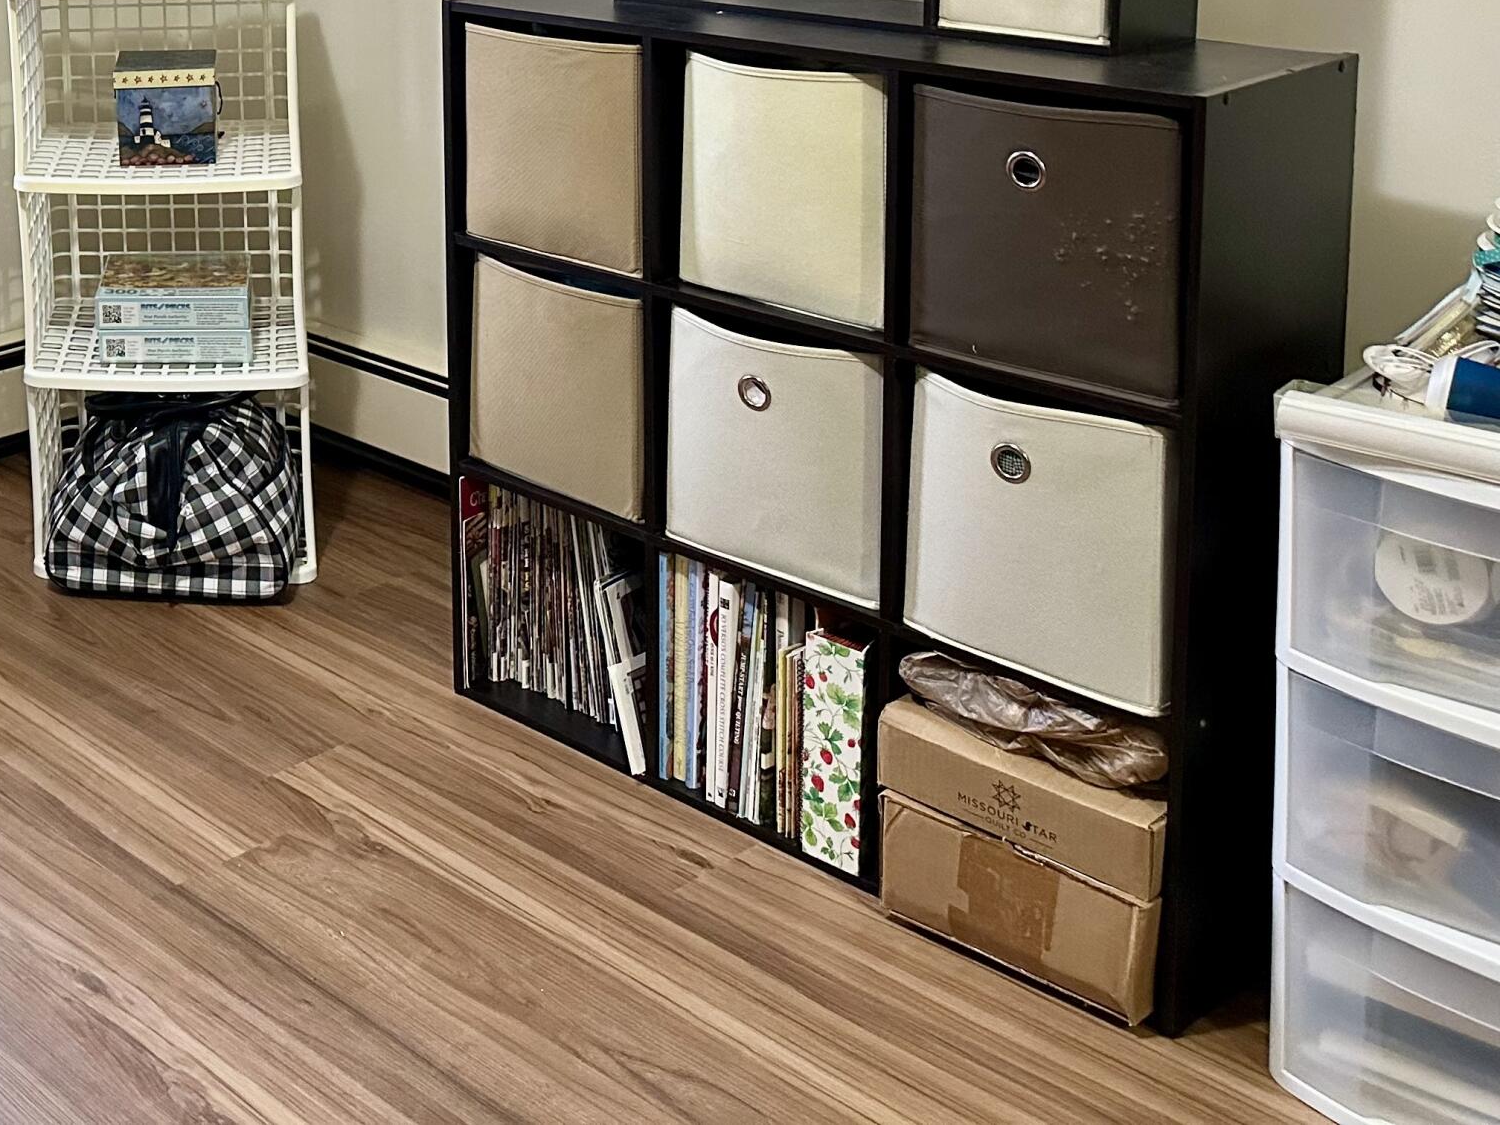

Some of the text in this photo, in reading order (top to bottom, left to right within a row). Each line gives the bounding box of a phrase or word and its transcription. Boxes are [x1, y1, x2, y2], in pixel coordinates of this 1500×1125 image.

[719, 652, 727, 690] COMPLETE
[733, 712, 741, 744] QUILTING
[957, 791, 1058, 843] MISSOURI STAR
[985, 816, 1027, 839] QUILT CO
